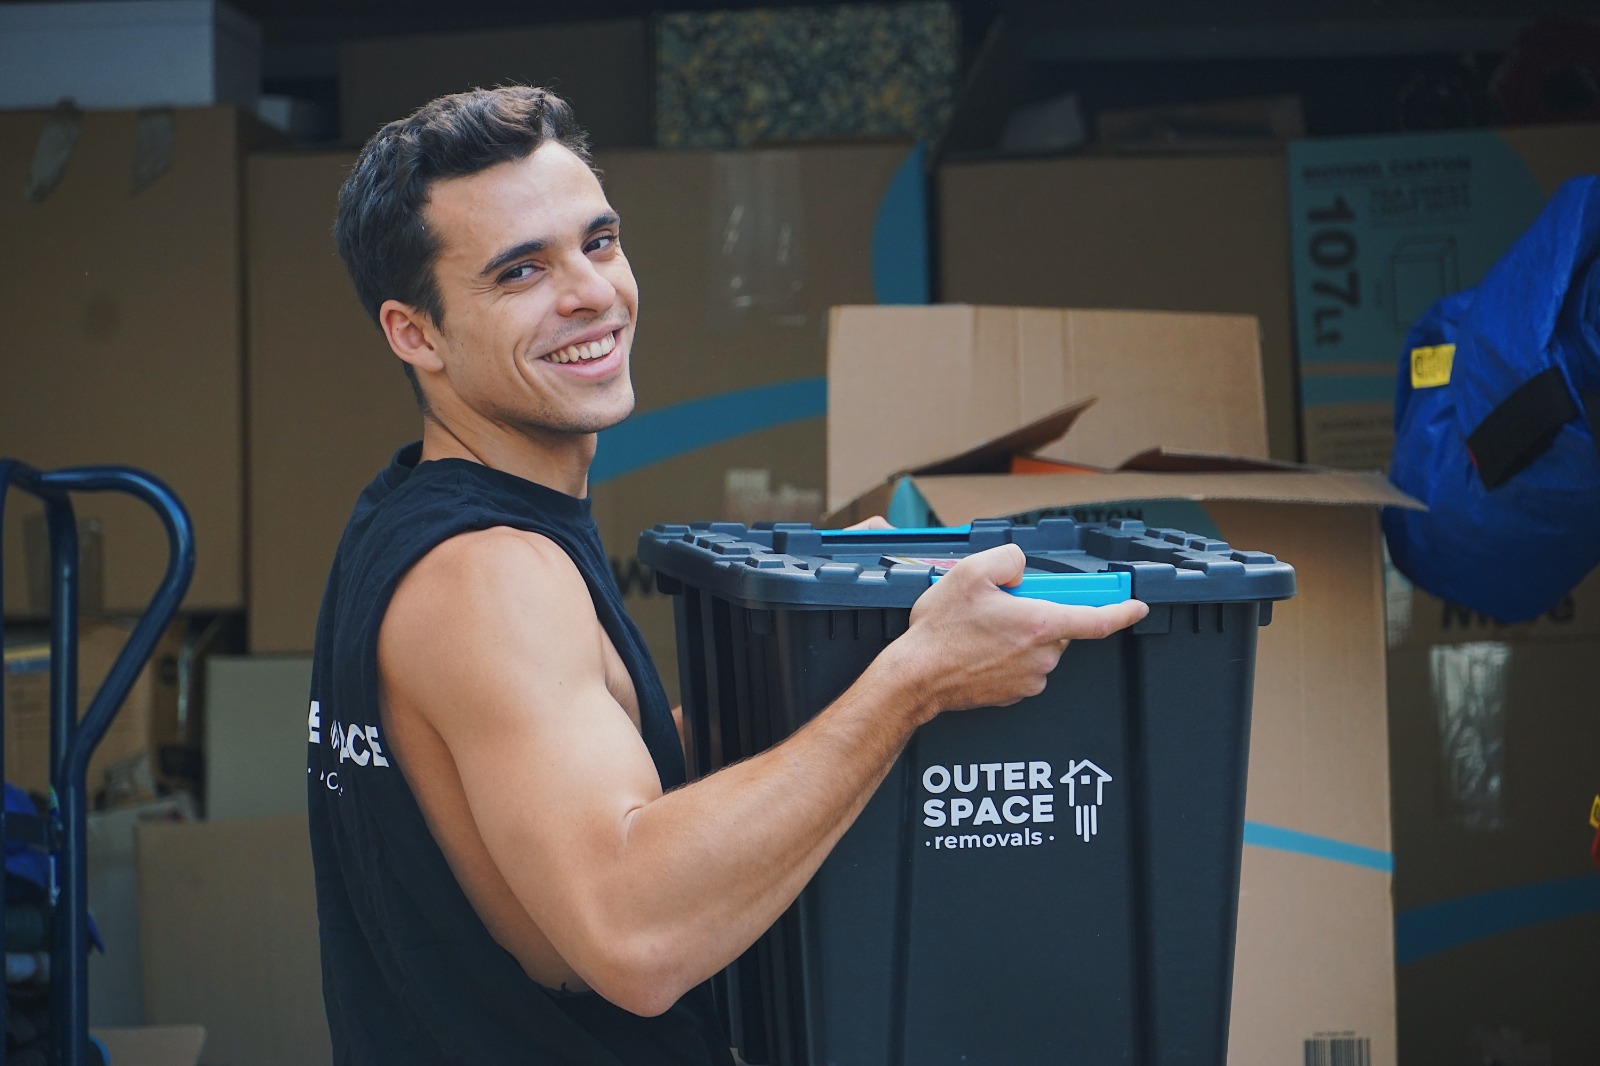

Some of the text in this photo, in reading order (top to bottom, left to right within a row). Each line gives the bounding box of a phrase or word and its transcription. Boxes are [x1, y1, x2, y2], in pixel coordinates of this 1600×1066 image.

[1388, 155, 1472, 175] CARTON
[922, 761, 1053, 794] OUTER
[923, 794, 1054, 828] SPACE
[935, 828, 1043, 849] removals
